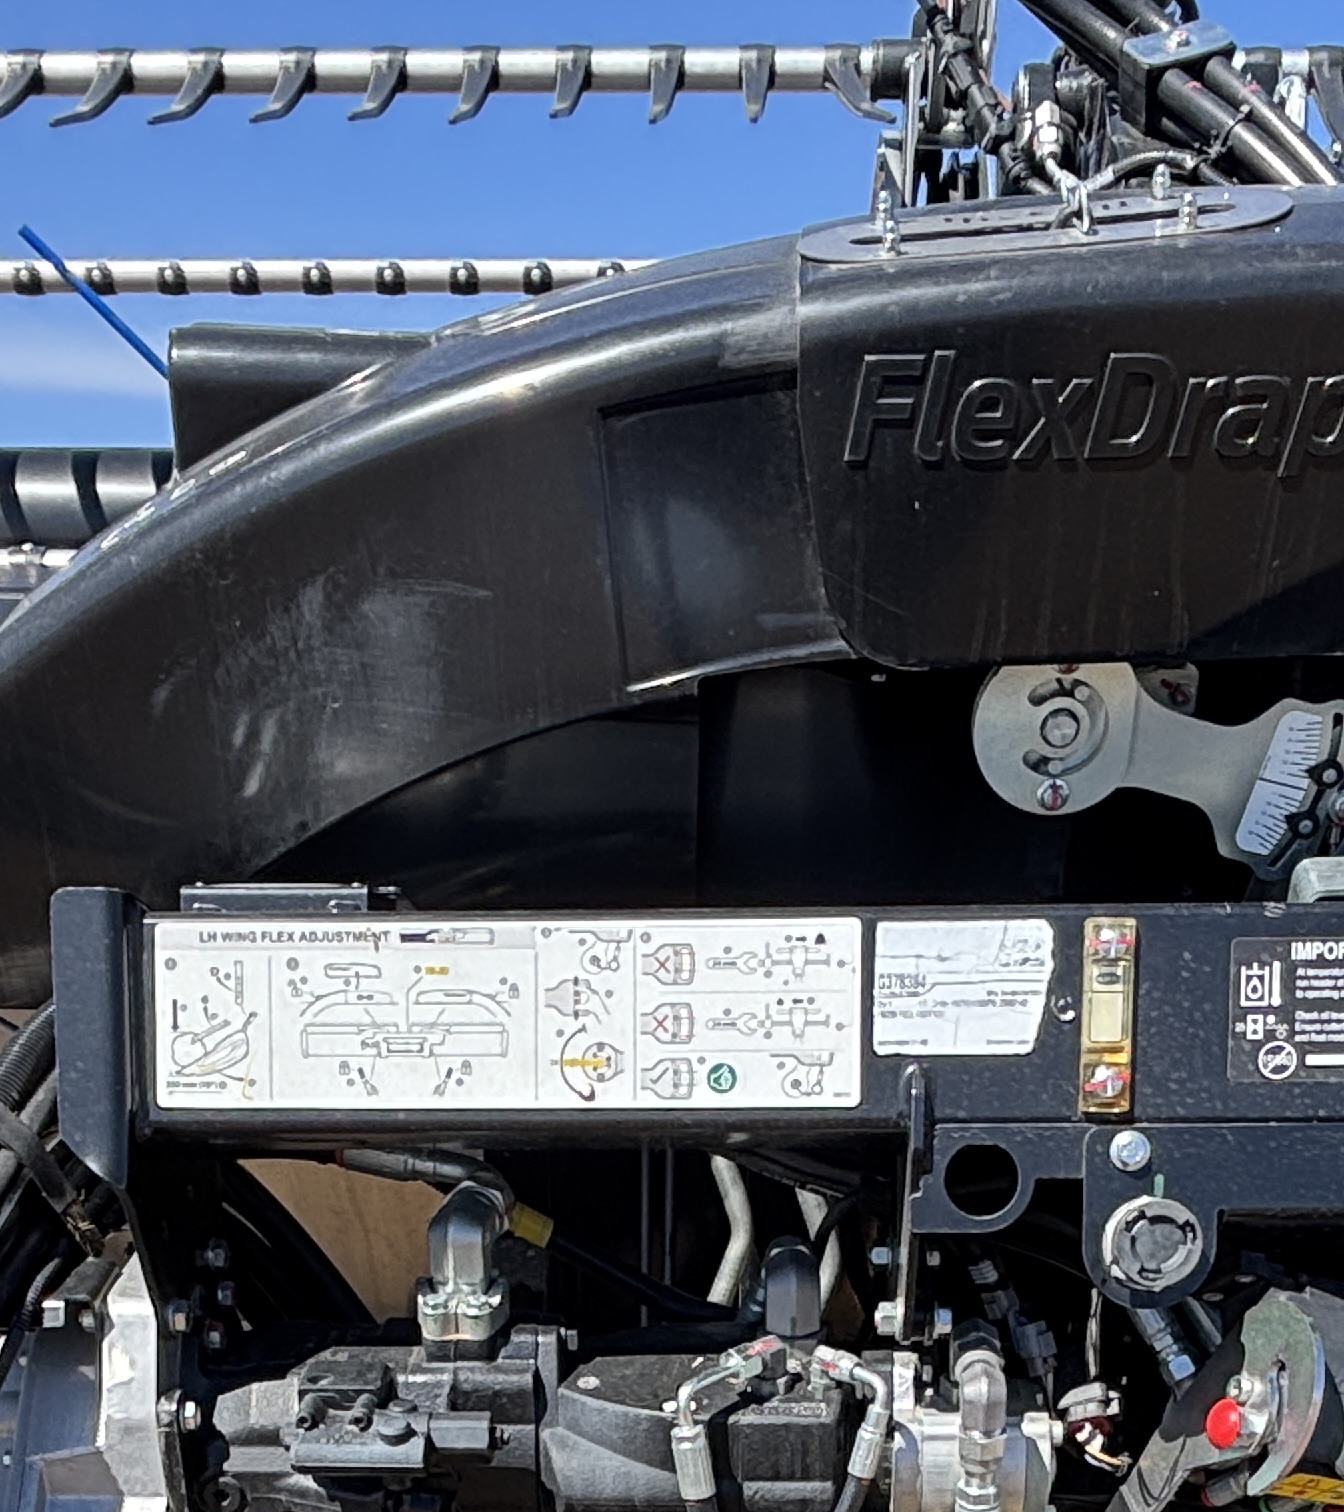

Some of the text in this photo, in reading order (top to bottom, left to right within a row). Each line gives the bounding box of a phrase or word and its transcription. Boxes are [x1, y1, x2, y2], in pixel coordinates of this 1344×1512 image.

[199, 930, 391, 943] LH WING FLEX ADJUSTMENT
